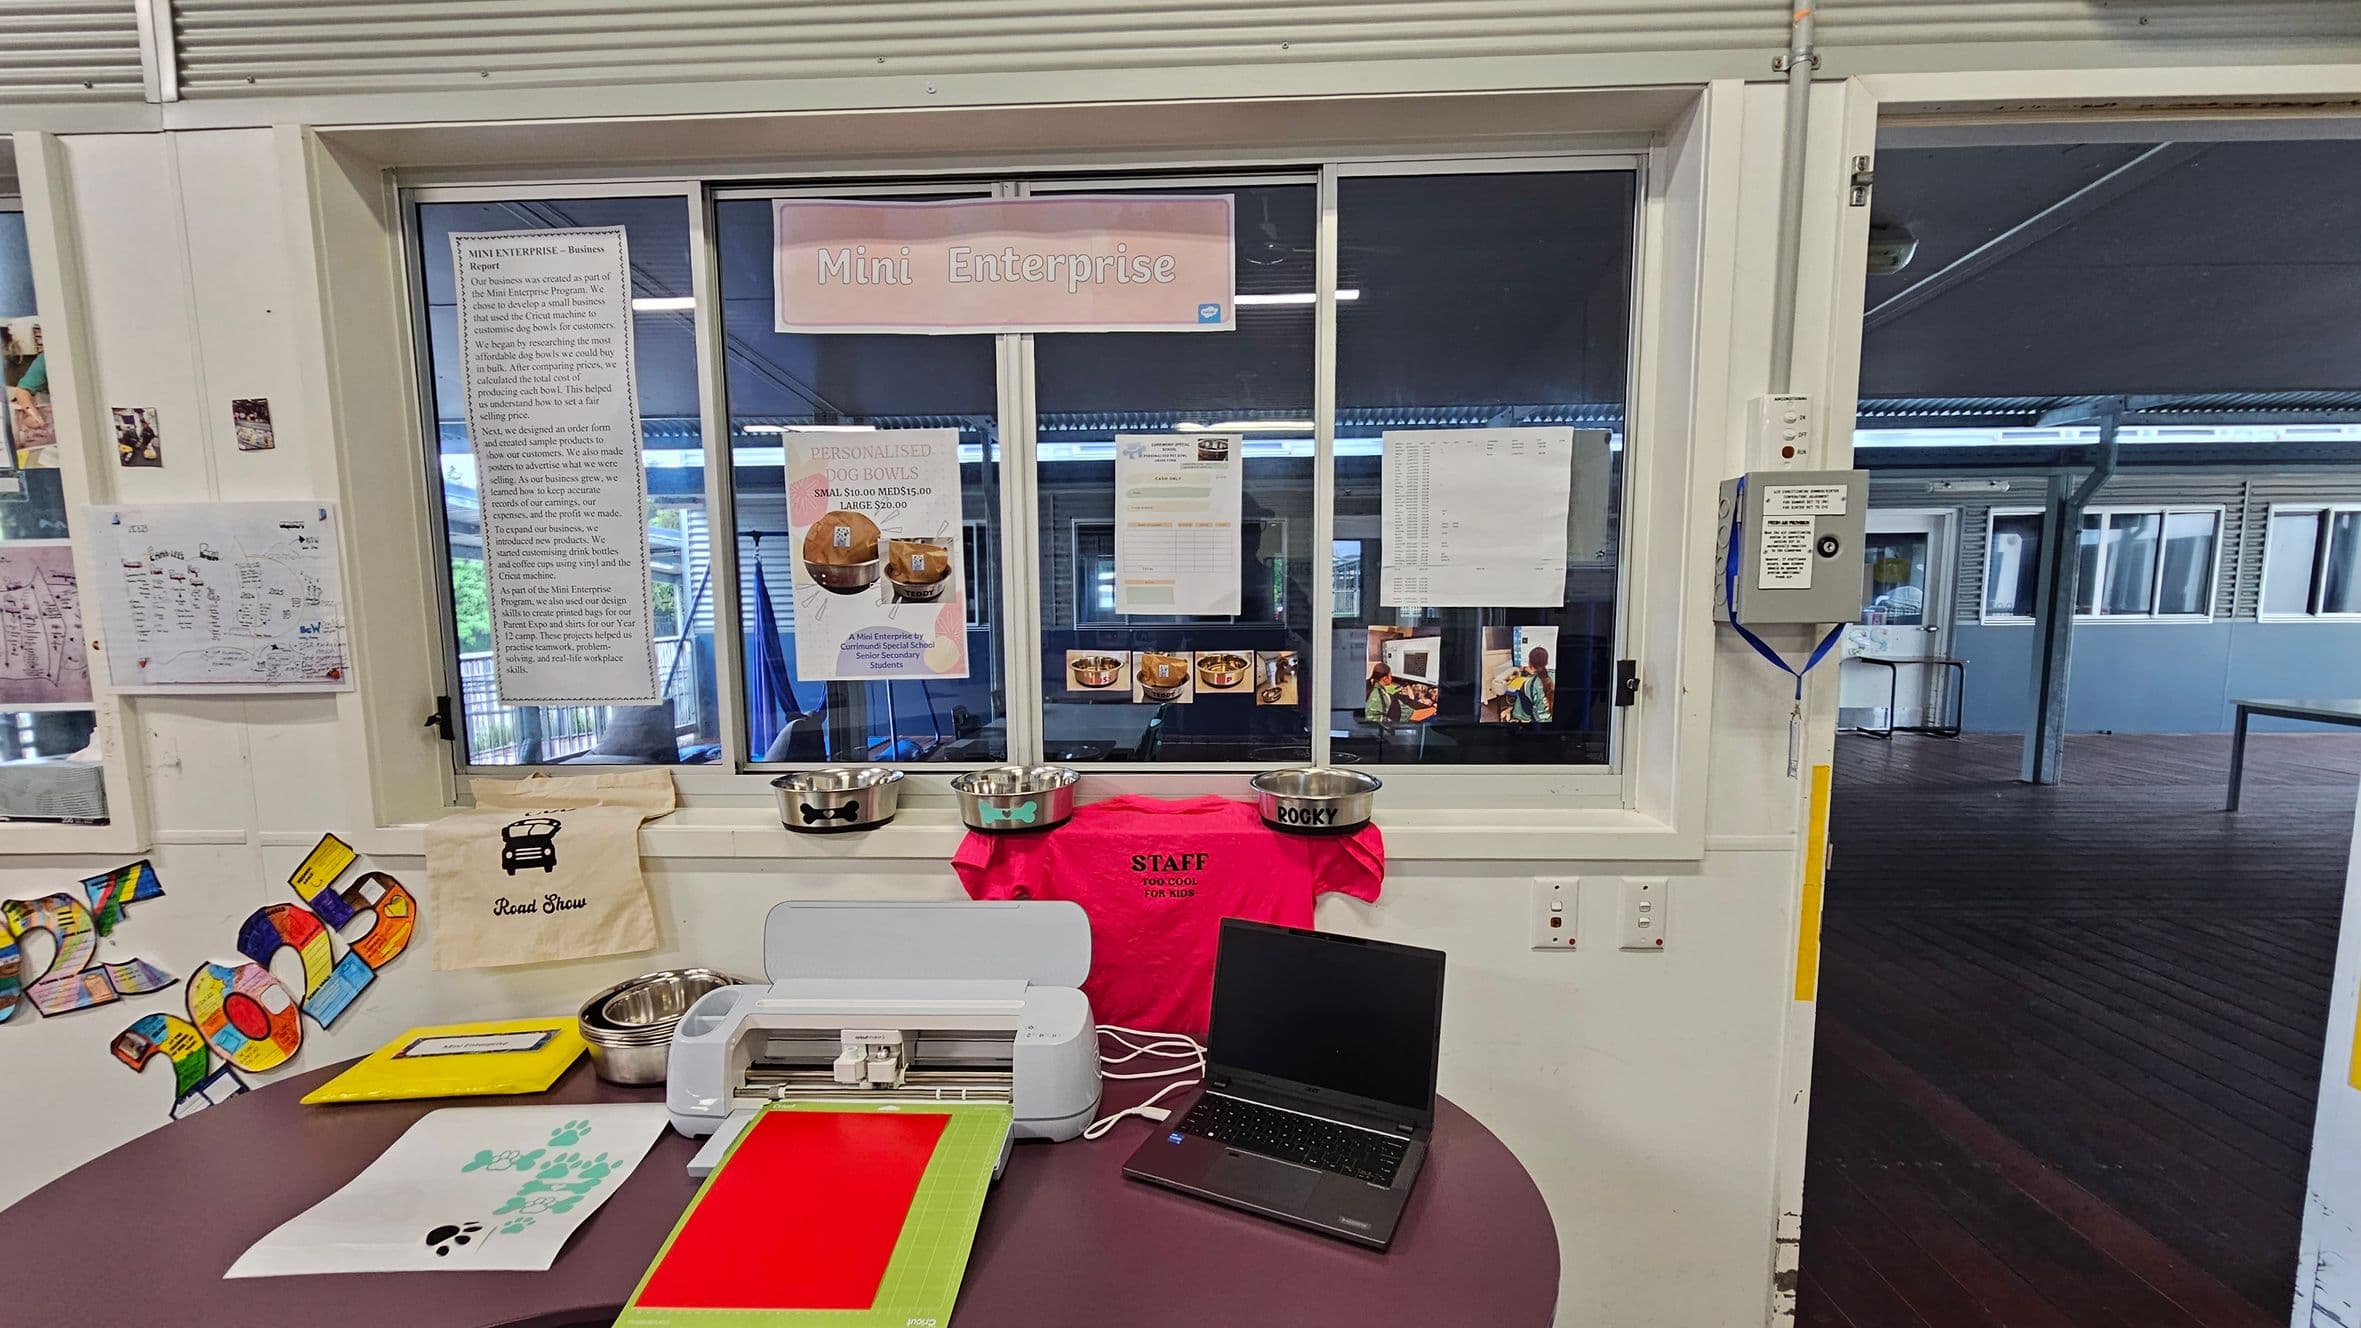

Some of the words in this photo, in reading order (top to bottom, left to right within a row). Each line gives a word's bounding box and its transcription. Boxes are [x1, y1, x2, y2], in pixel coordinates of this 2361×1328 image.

[496, 247, 558, 256] ENTERPRISE
[569, 246, 604, 254] Business
[470, 261, 500, 272] Report
[817, 246, 912, 285] Mini
[948, 244, 1176, 294] Enterprise
[471, 277, 488, 285] Our
[489, 276, 524, 285] business
[542, 274, 572, 283] created
[584, 273, 601, 284] part
[601, 273, 610, 281] of
[472, 289, 486, 297] the
[486, 288, 506, 297] Mini
[508, 287, 550, 299] Enterprise
[550, 286, 589, 298] Program.
[590, 285, 605, 294] We
[473, 301, 496, 309] chose
[498, 300, 507, 309] to
[507, 299, 540, 311] develop
[547, 298, 571, 307] small
[572, 298, 606, 306] business
[474, 313, 488, 322] that
[491, 312, 509, 321] used
[511, 312, 524, 320] the
[525, 311, 552, 320] Cricut
[552, 310, 587, 319] machine
[588, 309, 597, 318] to
[474, 324, 515, 333] customise
[516, 324, 532, 335] dog
[532, 323, 558, 332] bowls
[560, 323, 572, 331] for
[572, 321, 616, 331] customers.
[476, 340, 490, 348] We
[491, 339, 516, 351] began
[516, 338, 528, 350] by
[529, 337, 576, 349] researching
[577, 337, 590, 345] the
[591, 336, 612, 345] most
[475, 351, 516, 360] affordable
[518, 350, 534, 362] dog
[535, 350, 560, 359] bowls
[575, 349, 599, 358] could
[599, 348, 615, 360] buy
[476, 364, 485, 372] in
[487, 363, 508, 372] bulk.
[509, 362, 531, 372] After
[531, 361, 576, 373] comparing
[576, 360, 604, 372] prices,
[477, 374, 519, 384] calculated
[519, 374, 533, 383] the
[533, 374, 552, 383] total
[553, 373, 571, 382] cost
[572, 373, 582, 382] of
[478, 386, 519, 398] producing
[519, 386, 539, 395] each
[539, 386, 564, 394] bowl.
[565, 385, 584, 394] This
[585, 384, 612, 396] helped
[489, 398, 534, 408] understand
[534, 398, 553, 406] how
[553, 398, 563, 406] to
[564, 397, 577, 406] set
[585, 397, 599, 405] fair
[811, 444, 932, 460] PERSONALISED
[826, 468, 858, 481] DOG
[864, 467, 919, 480] BOWLS
[814, 489, 842, 497] SMAL
[844, 488, 876, 497] $10.00
[878, 487, 931, 496] MED$15.00
[840, 502, 873, 510] LARGE
[874, 501, 907, 510] $20.00
[500, 586, 511, 594] As
[511, 586, 527, 596] part
[527, 586, 537, 594] of
[537, 586, 550, 594] the
[551, 585, 569, 594] Mini
[571, 585, 612, 596] Enterprise
[501, 597, 535, 608] Program,
[548, 597, 565, 605] also
[565, 597, 584, 605] used
[601, 596, 626, 607] design
[556, 608, 584, 619] printed
[584, 608, 604, 618] bags
[528, 620, 548, 630] Expo
[504, 632, 514, 640] 12
[515, 634, 538, 642] camp.
[540, 631, 562, 639] These
[563, 631, 594, 642] projects
[594, 631, 621, 641] helped
[874, 633, 912, 641] Enterprise
[915, 633, 923, 641] by
[505, 643, 534, 653] practise
[535, 643, 575, 651] teamwork,
[576, 643, 611, 653] problem-
[883, 642, 909, 651] Special
[506, 654, 535, 665] solving,
[537, 654, 550, 662] and
[552, 654, 583, 662] real-life
[583, 654, 623, 664] workplace
[881, 651, 920, 660] Secondary
[1277, 806, 1338, 825] ROCKY
[1131, 854, 1209, 872] STAFF
[494, 897, 537, 917] Road
[542, 894, 588, 914] Show
